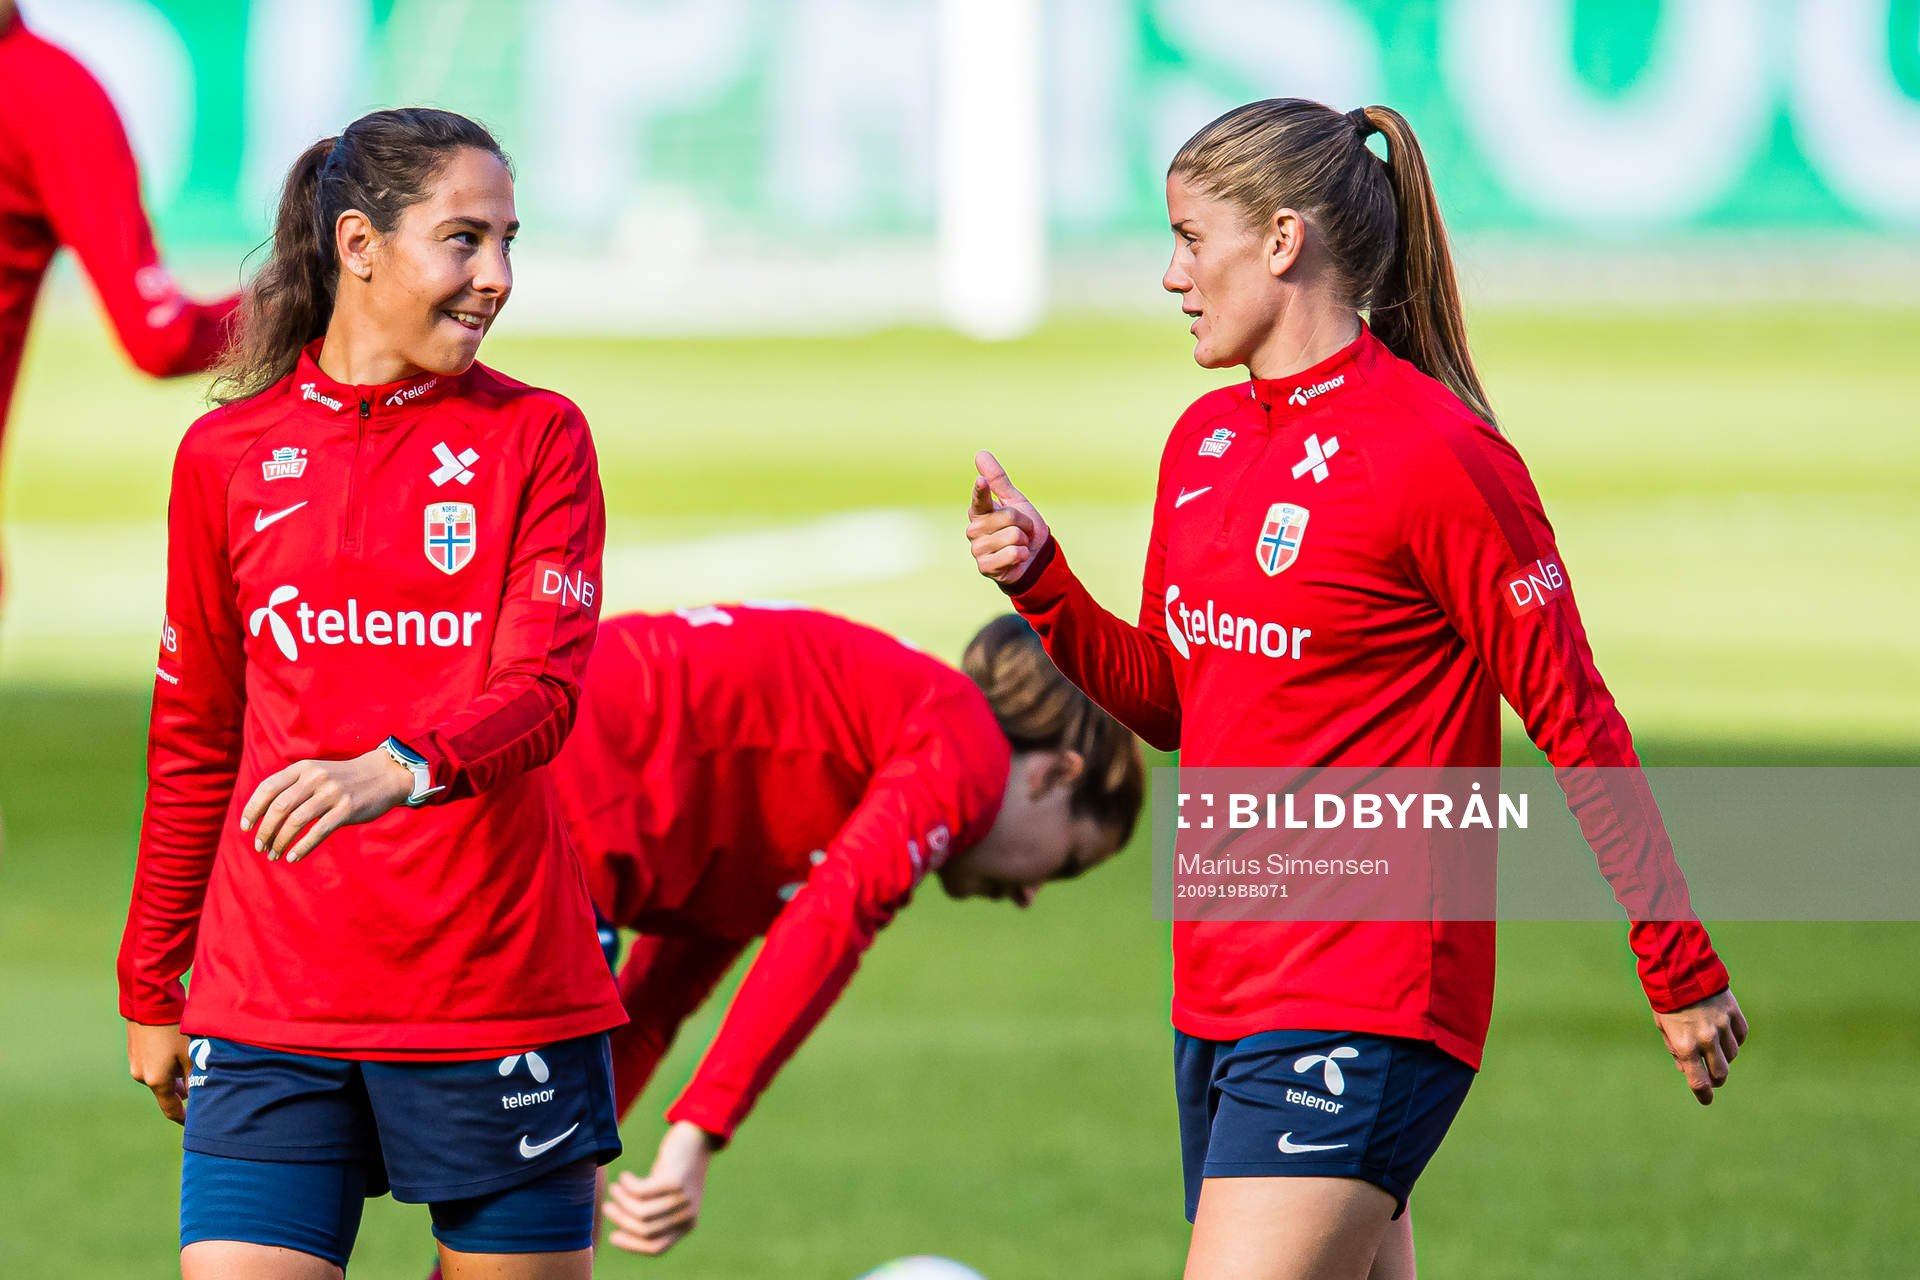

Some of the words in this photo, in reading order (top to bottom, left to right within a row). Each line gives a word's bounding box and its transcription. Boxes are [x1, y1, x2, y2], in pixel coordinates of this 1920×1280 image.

[402, 377, 438, 401] telenor
[1302, 374, 1345, 399] telenor
[1204, 441, 1227, 454] TINE
[268, 462, 300, 477] TINE
[542, 569, 595, 608] DNB
[1509, 559, 1563, 607] DNB
[297, 598, 482, 647] telenor
[1178, 599, 1312, 660] telenor
[501, 1089, 555, 1110] telenor
[1285, 1088, 1344, 1115] telenor
